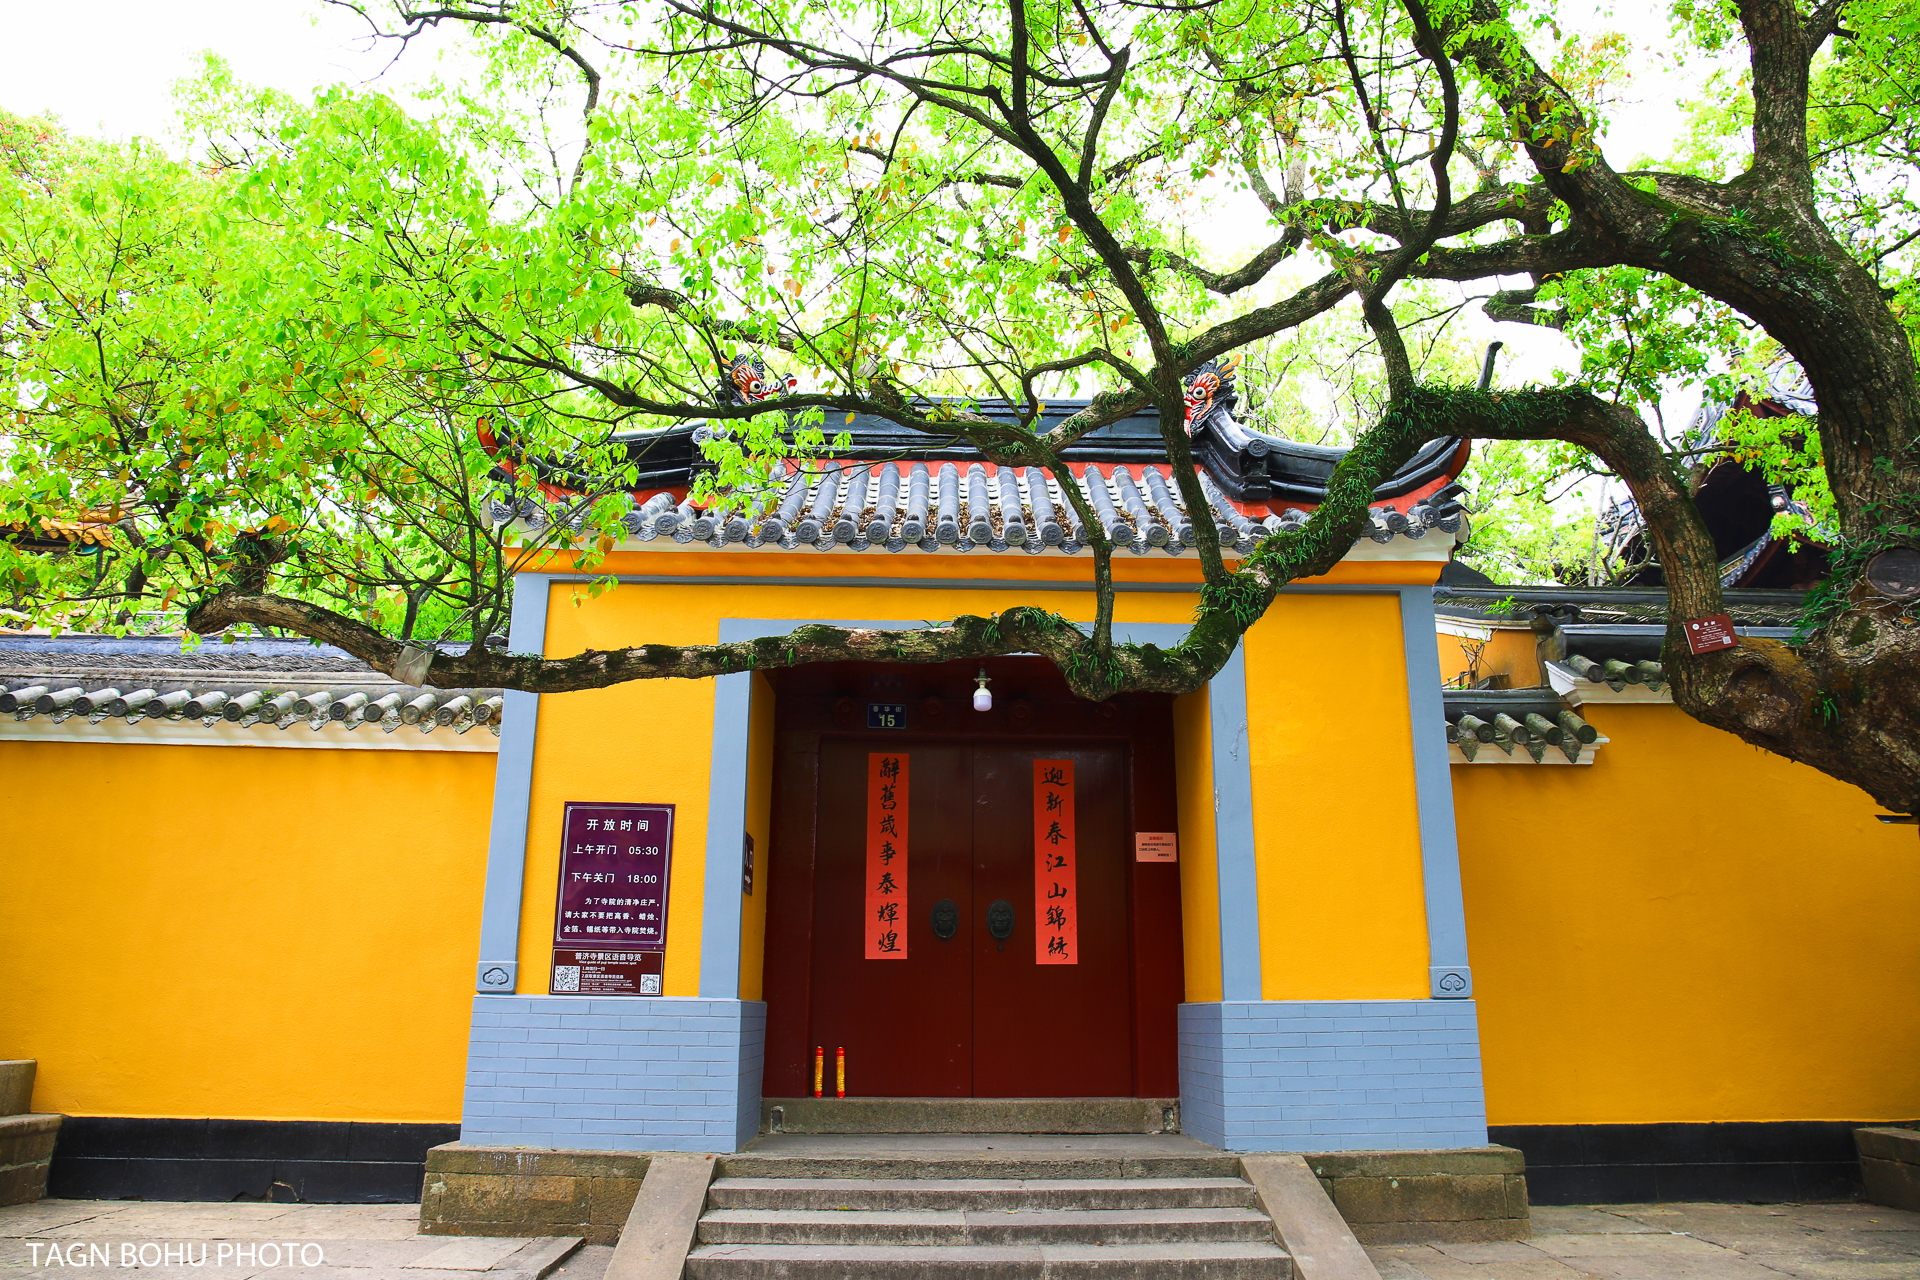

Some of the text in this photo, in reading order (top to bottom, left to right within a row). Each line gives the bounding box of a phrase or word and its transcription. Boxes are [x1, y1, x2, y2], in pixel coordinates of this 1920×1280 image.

[879, 714, 895, 727] 15
[586, 818, 649, 832] 开放时间
[572, 843, 659, 856] 上午开门 05:30
[571, 872, 657, 884] 下午关门 18:00
[575, 951, 642, 961] 普济寺景区语音导览
